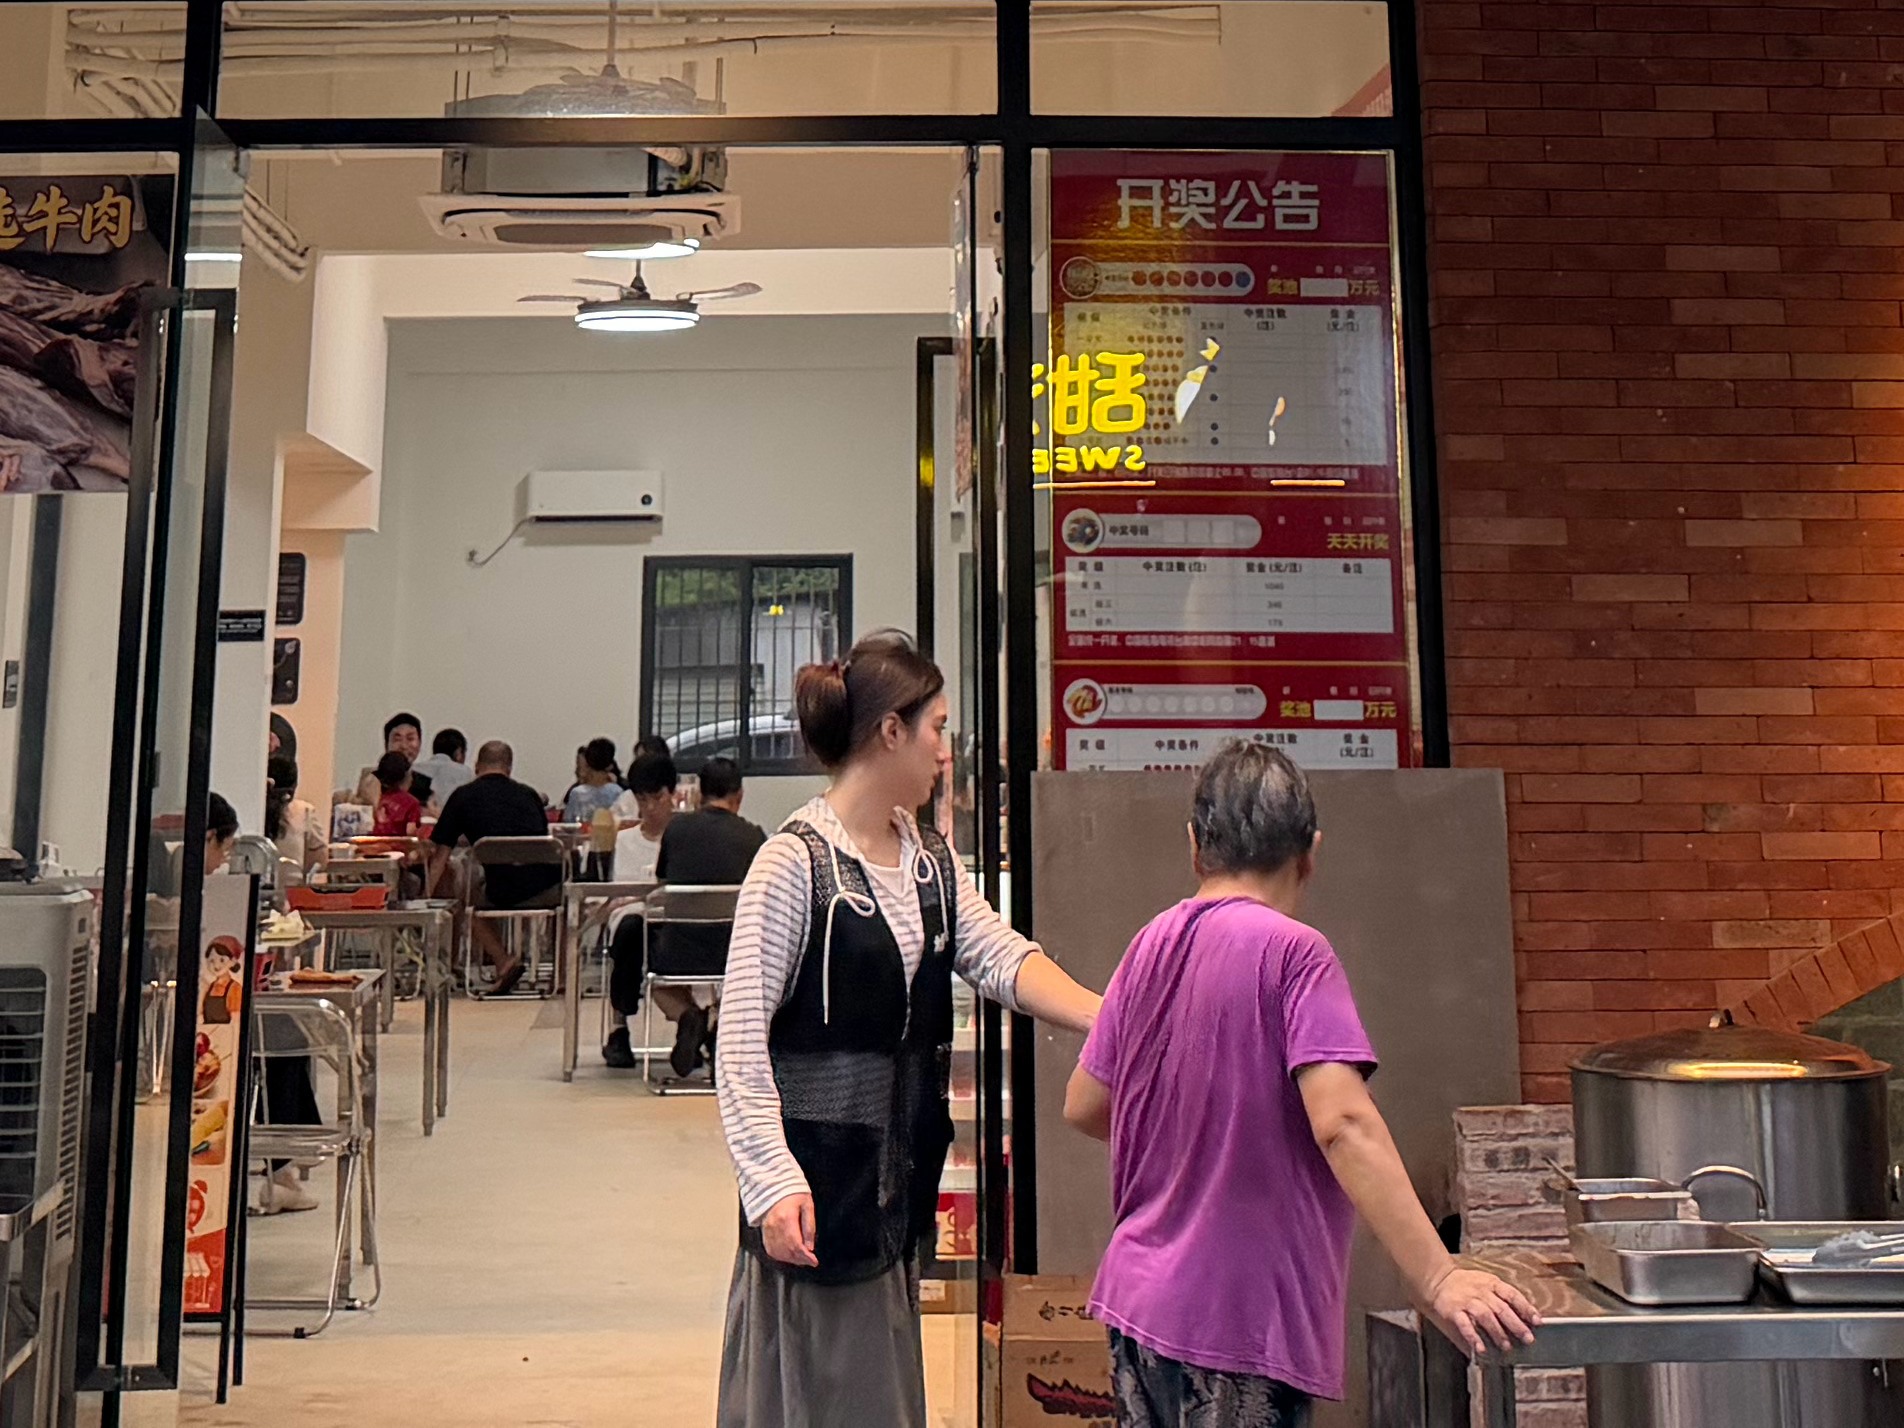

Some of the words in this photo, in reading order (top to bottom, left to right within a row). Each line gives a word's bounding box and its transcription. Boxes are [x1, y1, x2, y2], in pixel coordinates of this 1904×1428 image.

[1116, 178, 1321, 231] 开奖公告
[1327, 532, 1390, 550] 天天开奖
